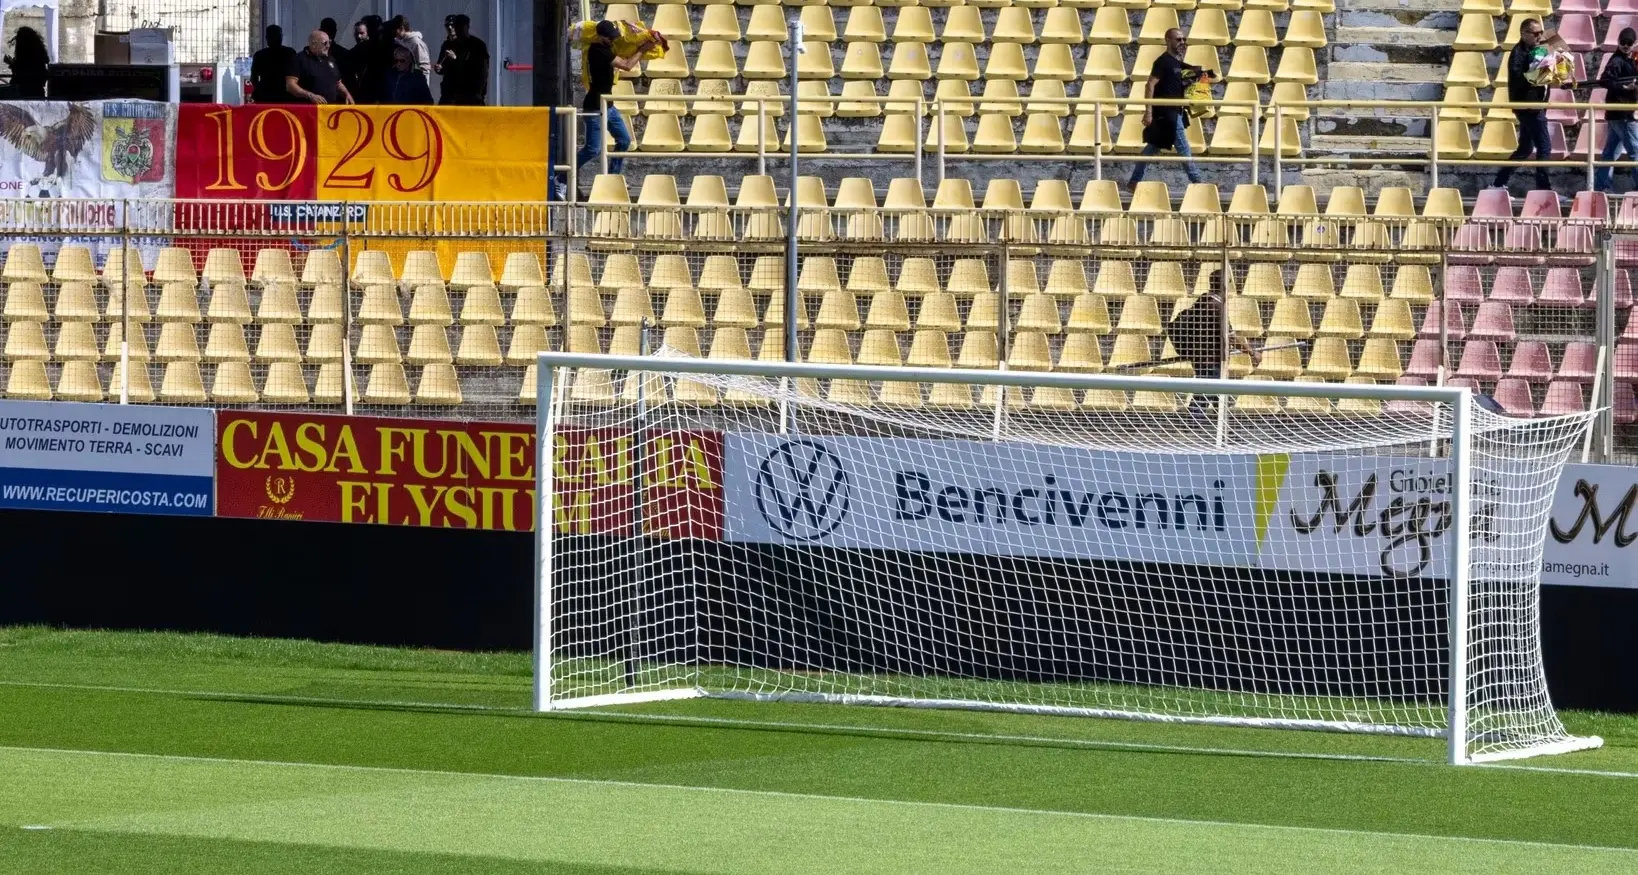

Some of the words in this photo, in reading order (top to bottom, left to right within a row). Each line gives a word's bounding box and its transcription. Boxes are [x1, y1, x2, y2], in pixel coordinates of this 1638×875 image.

[204, 108, 444, 192] 1929
[296, 204, 364, 217] CATANZRO
[5, 437, 84, 453] MOVIMENTO
[90, 440, 132, 455] TERRA
[144, 443, 184, 457] SCAVI
[113, 422, 199, 438] DEMOLIZIONI
[222, 419, 368, 476] CASA
[3, 484, 207, 508] WWW.RECUPERICOSTA.COM
[336, 481, 595, 534] ELYSIUM
[895, 470, 1225, 532] Bencivenni
